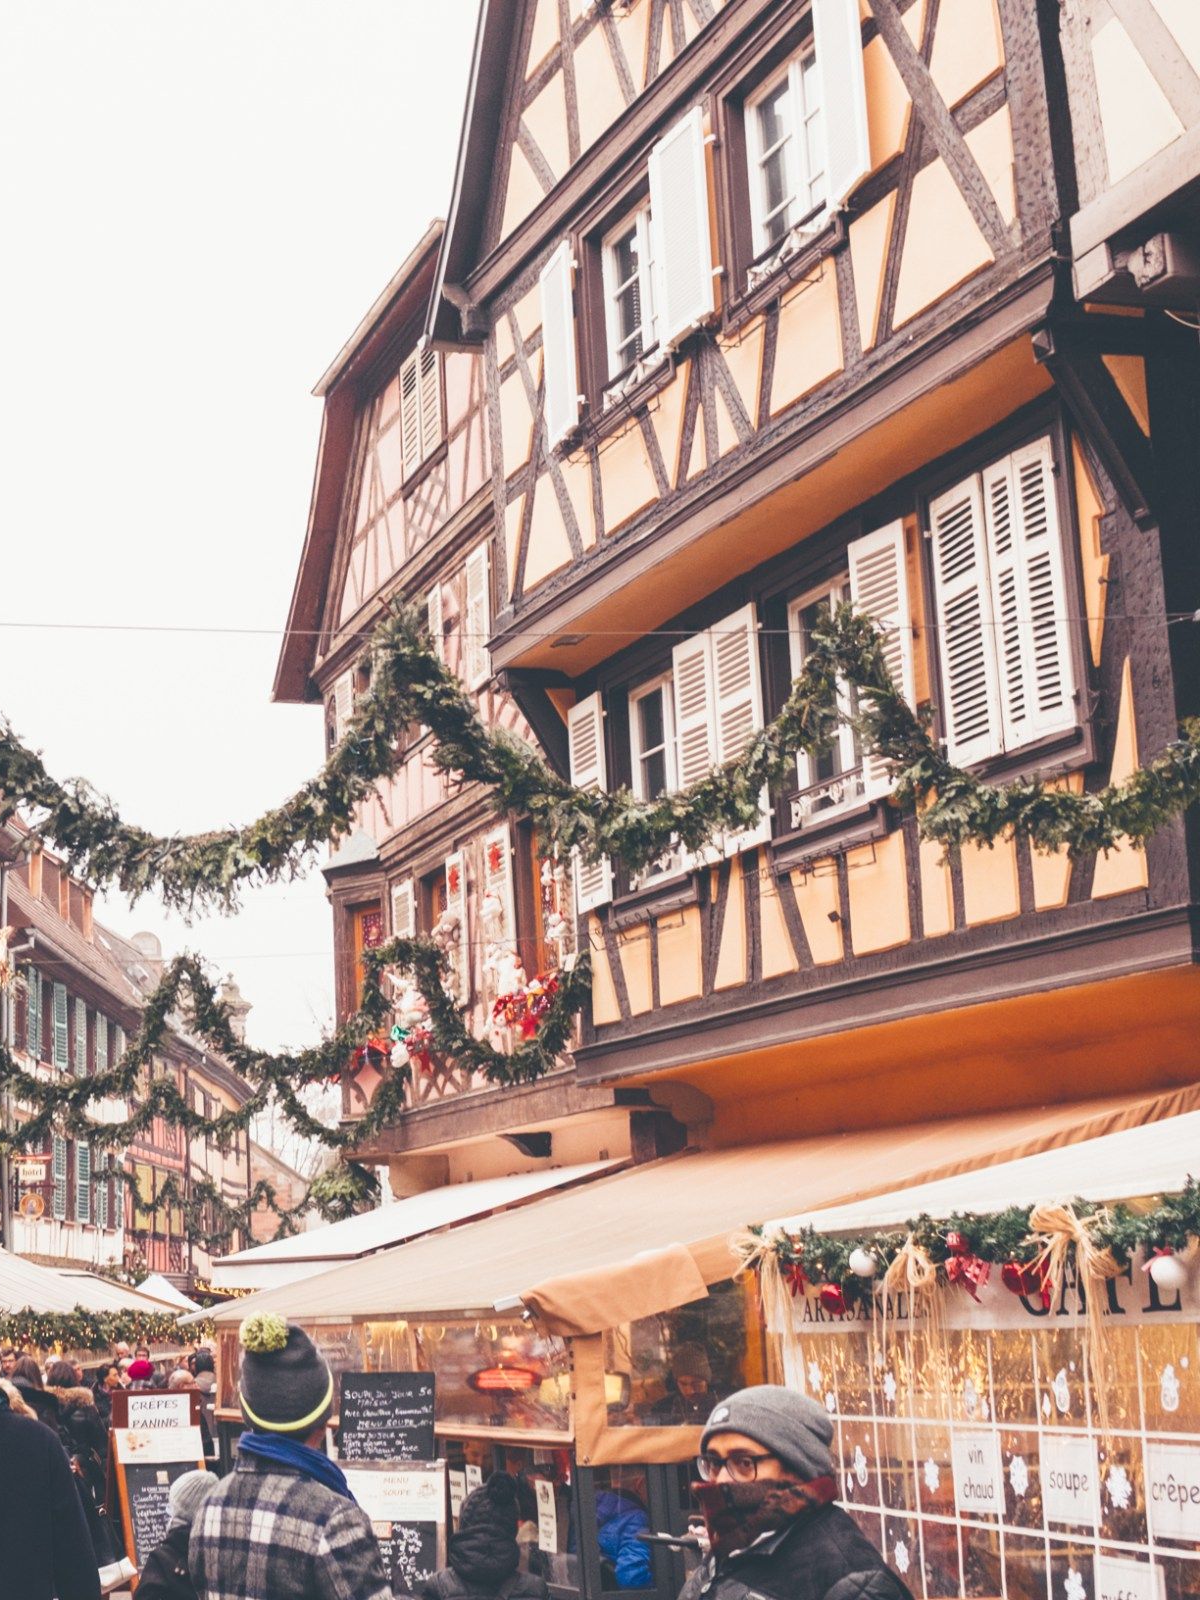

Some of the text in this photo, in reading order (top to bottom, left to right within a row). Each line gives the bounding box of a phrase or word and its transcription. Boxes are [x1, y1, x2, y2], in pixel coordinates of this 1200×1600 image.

[803, 1290, 932, 1322] ARSANALE
[131, 1398, 178, 1411] CRÊPES
[132, 1418, 178, 1429] PANINIS
[968, 1444, 984, 1465] vin
[963, 1477, 994, 1500] chaud
[1049, 1470, 1089, 1499] soupe
